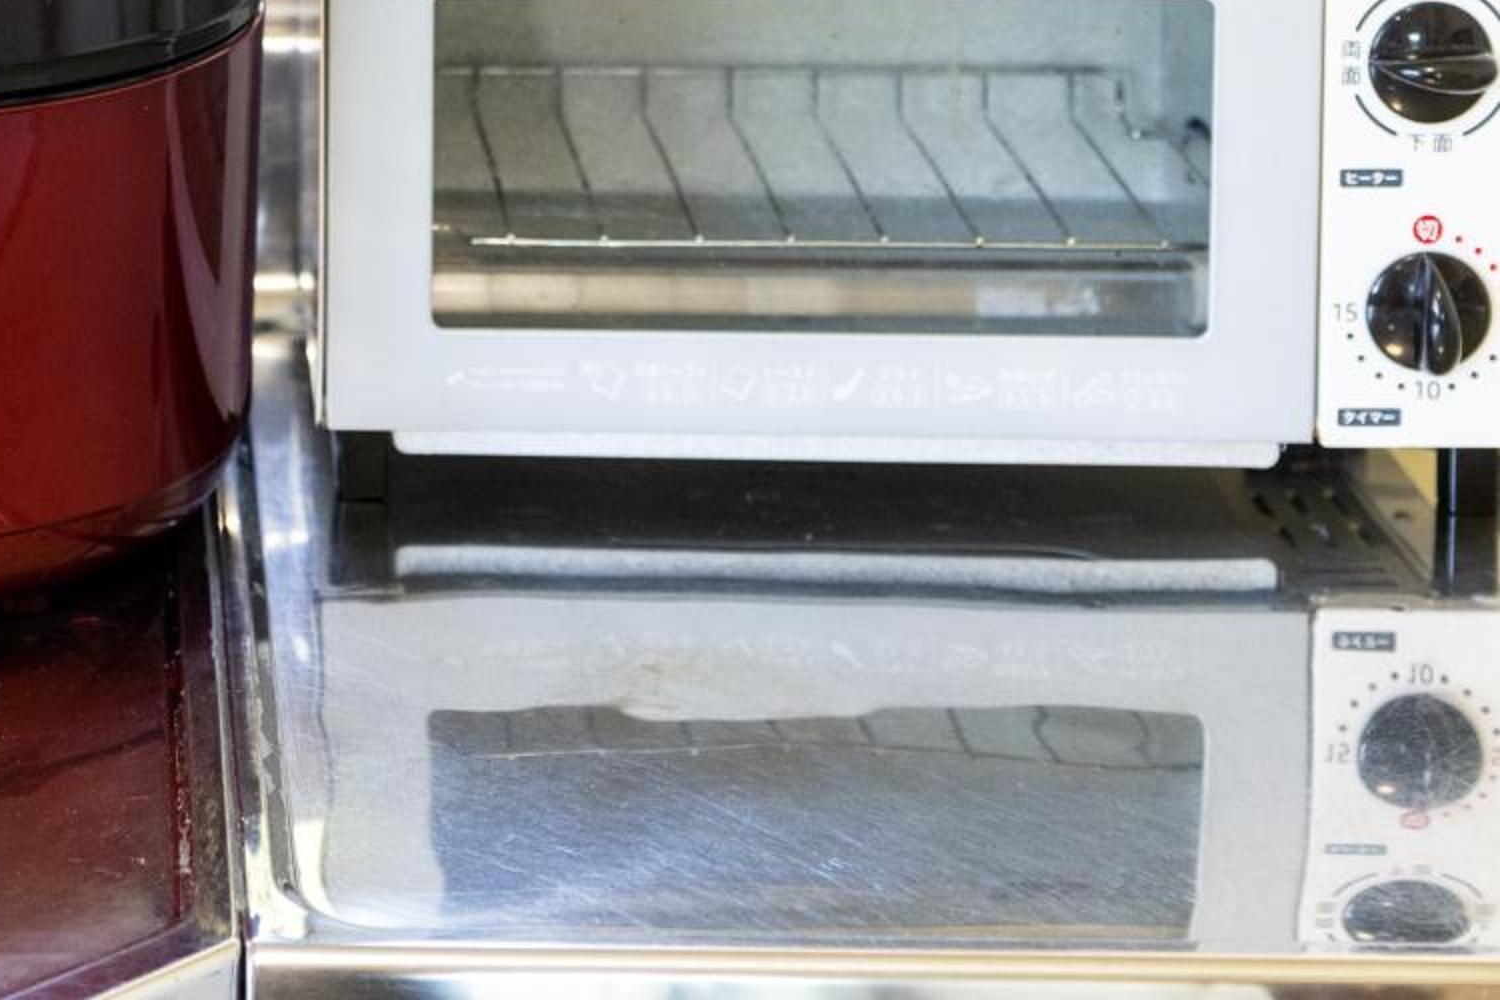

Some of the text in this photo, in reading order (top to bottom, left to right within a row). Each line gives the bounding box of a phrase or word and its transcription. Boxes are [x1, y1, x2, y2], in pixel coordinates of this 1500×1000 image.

[1344, 171, 1398, 186] ヒーター
[1334, 302, 1358, 323] 15
[1414, 380, 1442, 401] 10
[1342, 410, 1397, 425] タイマー
